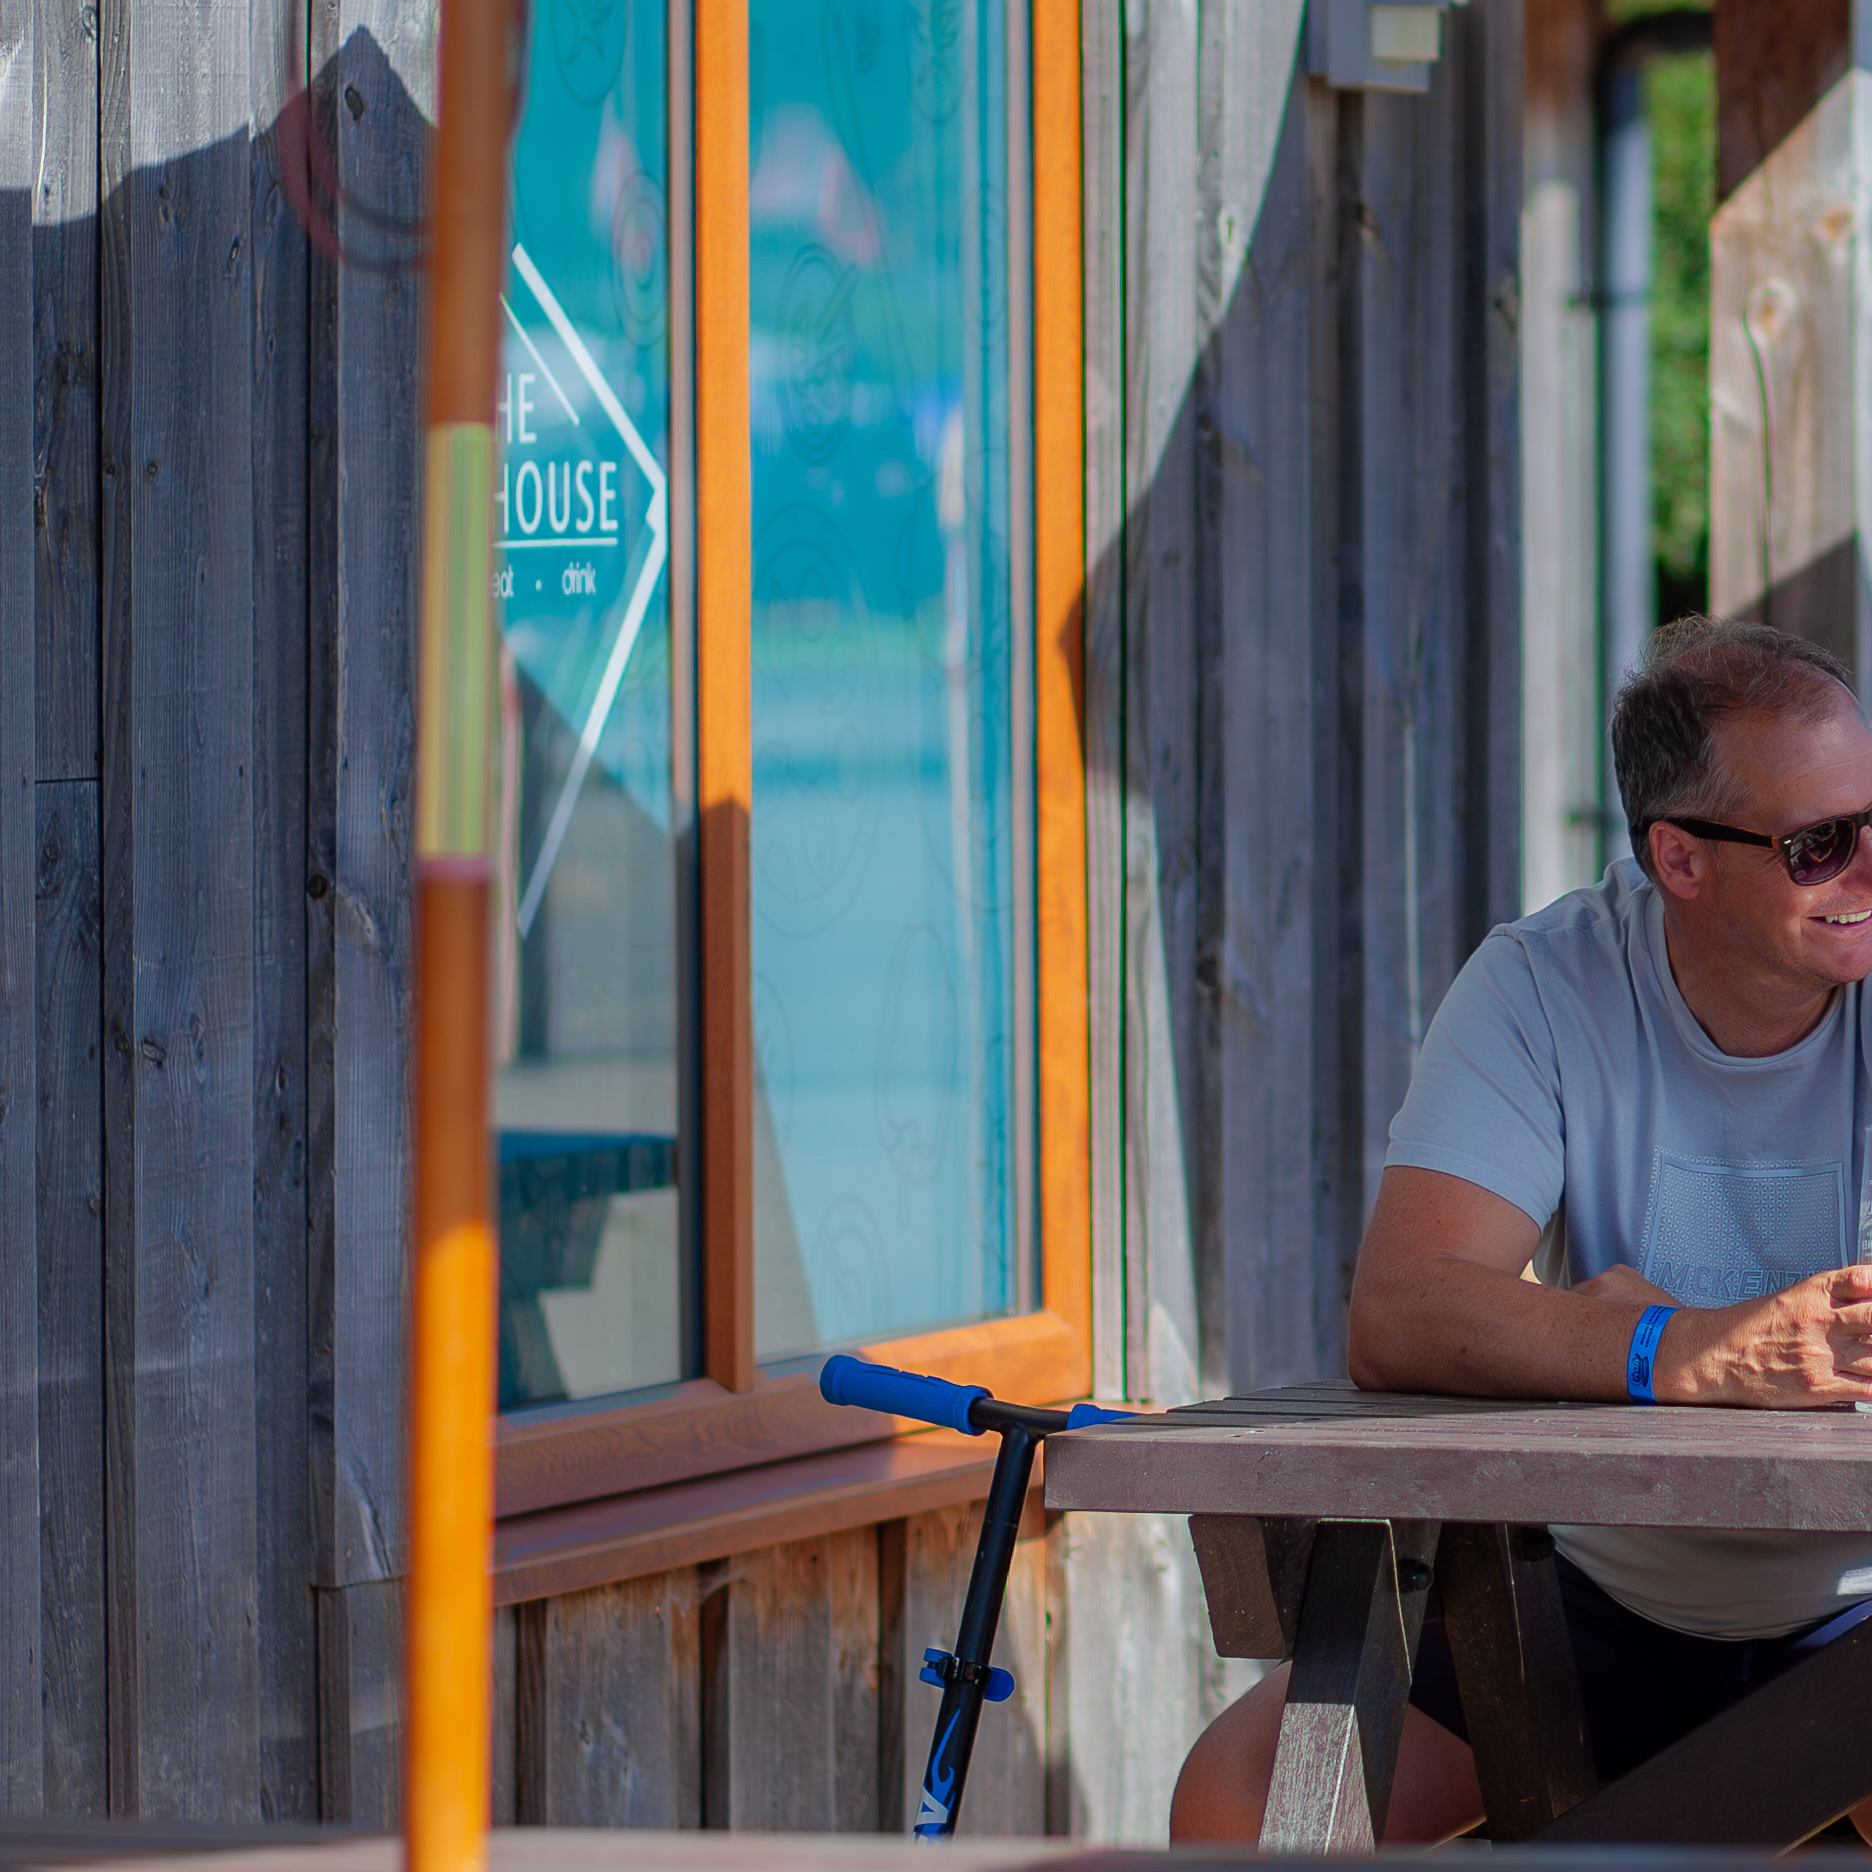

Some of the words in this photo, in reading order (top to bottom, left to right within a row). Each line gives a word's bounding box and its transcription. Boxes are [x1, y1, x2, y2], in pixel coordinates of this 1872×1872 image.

[496, 373, 537, 444] HE
[562, 560, 597, 596] drink
[1655, 1260, 1816, 1300] MCKENZ
